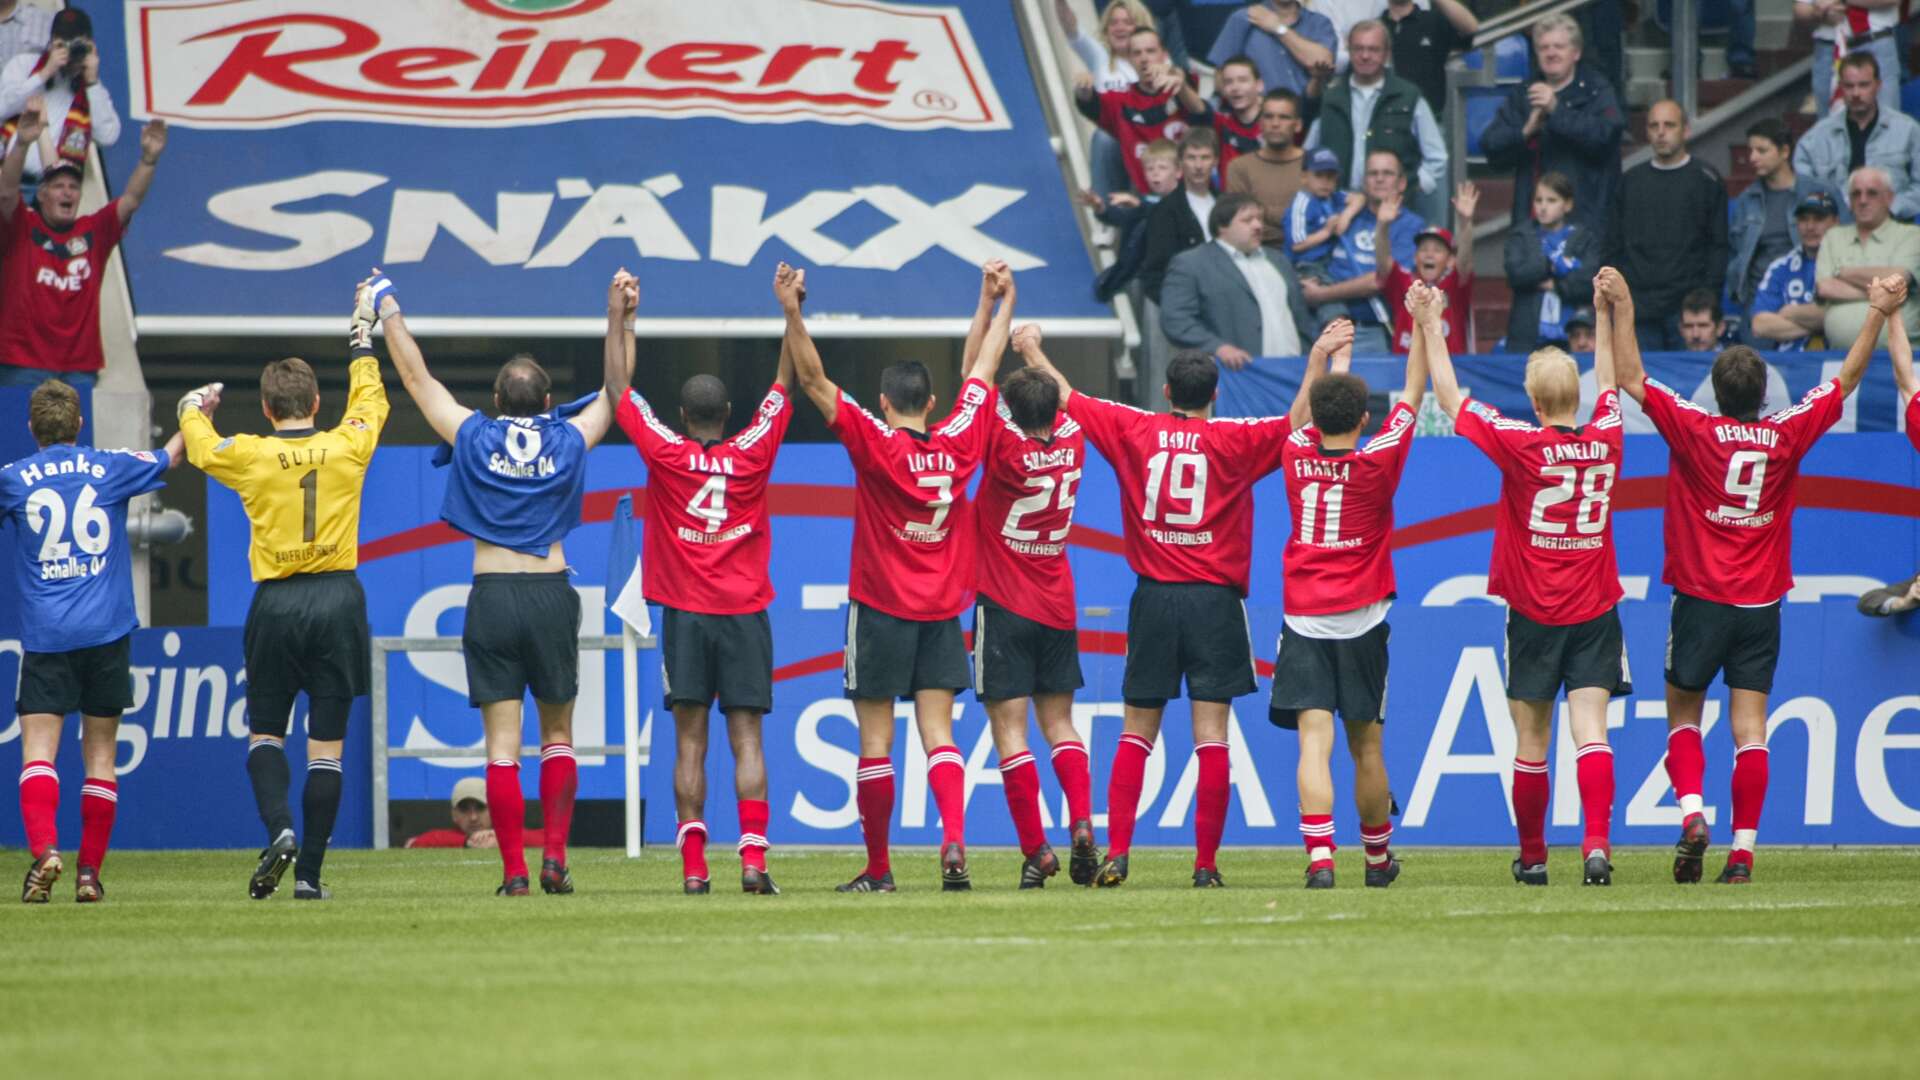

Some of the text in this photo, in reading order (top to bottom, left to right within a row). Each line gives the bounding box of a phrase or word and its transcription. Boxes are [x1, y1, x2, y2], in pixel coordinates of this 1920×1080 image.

[180, 14, 918, 107] Reinert
[162, 170, 1047, 270] SNÄKX
[488, 452, 556, 477] Schalke 04
[688, 454, 733, 475] JUAN
[1158, 428, 1200, 452] BABIC
[1542, 440, 1608, 465] RAMELOW
[1715, 424, 1779, 449] BERBATOV
[20, 454, 106, 487] Hanke
[1142, 451, 1208, 525] 19
[1528, 463, 1616, 535] 28
[1717, 450, 1768, 519] 9
[25, 483, 110, 562] 26
[299, 469, 317, 543] 1
[685, 475, 728, 533] 4
[904, 475, 953, 532] 3
[1001, 467, 1082, 542] 25
[1301, 481, 1344, 545] 11
[41, 556, 88, 580] Schalke
